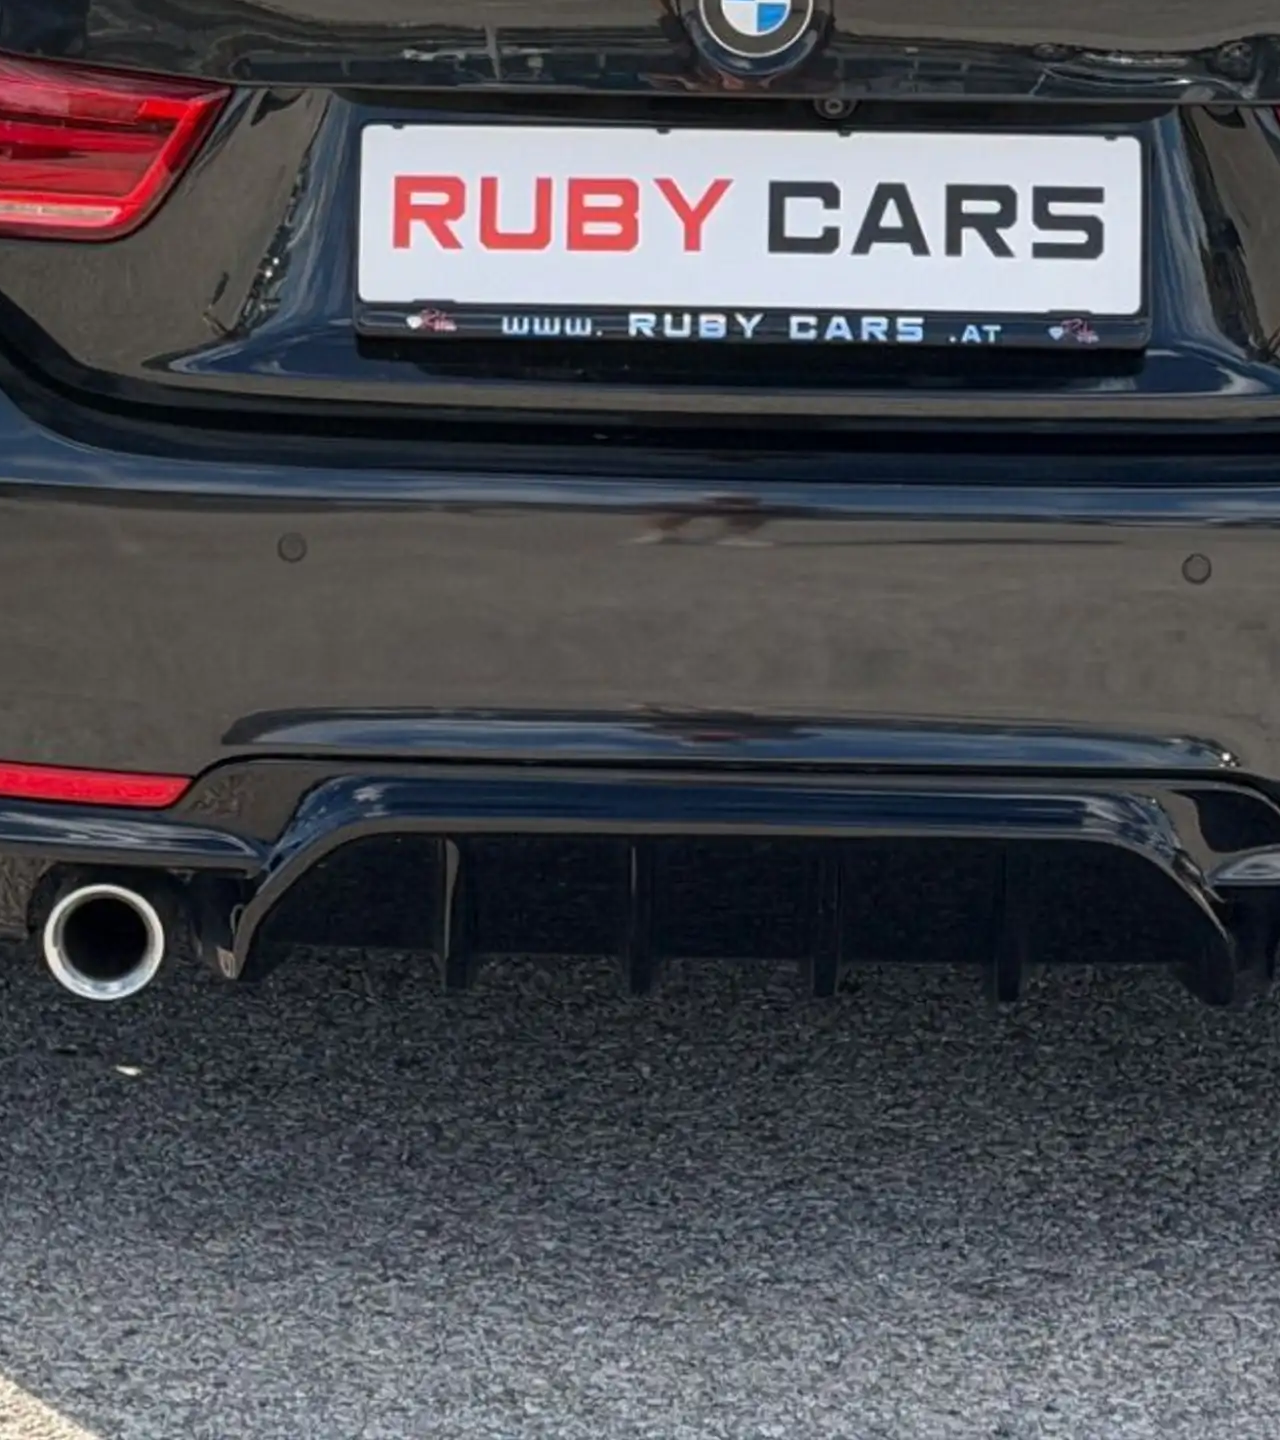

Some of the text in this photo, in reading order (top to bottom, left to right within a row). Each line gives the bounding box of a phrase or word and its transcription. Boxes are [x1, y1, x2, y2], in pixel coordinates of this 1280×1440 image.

[393, 175, 1105, 260] RUBY CARS
[627, 312, 765, 339] RUBY
[789, 314, 925, 343] CARS
[948, 324, 1002, 344] .AT
